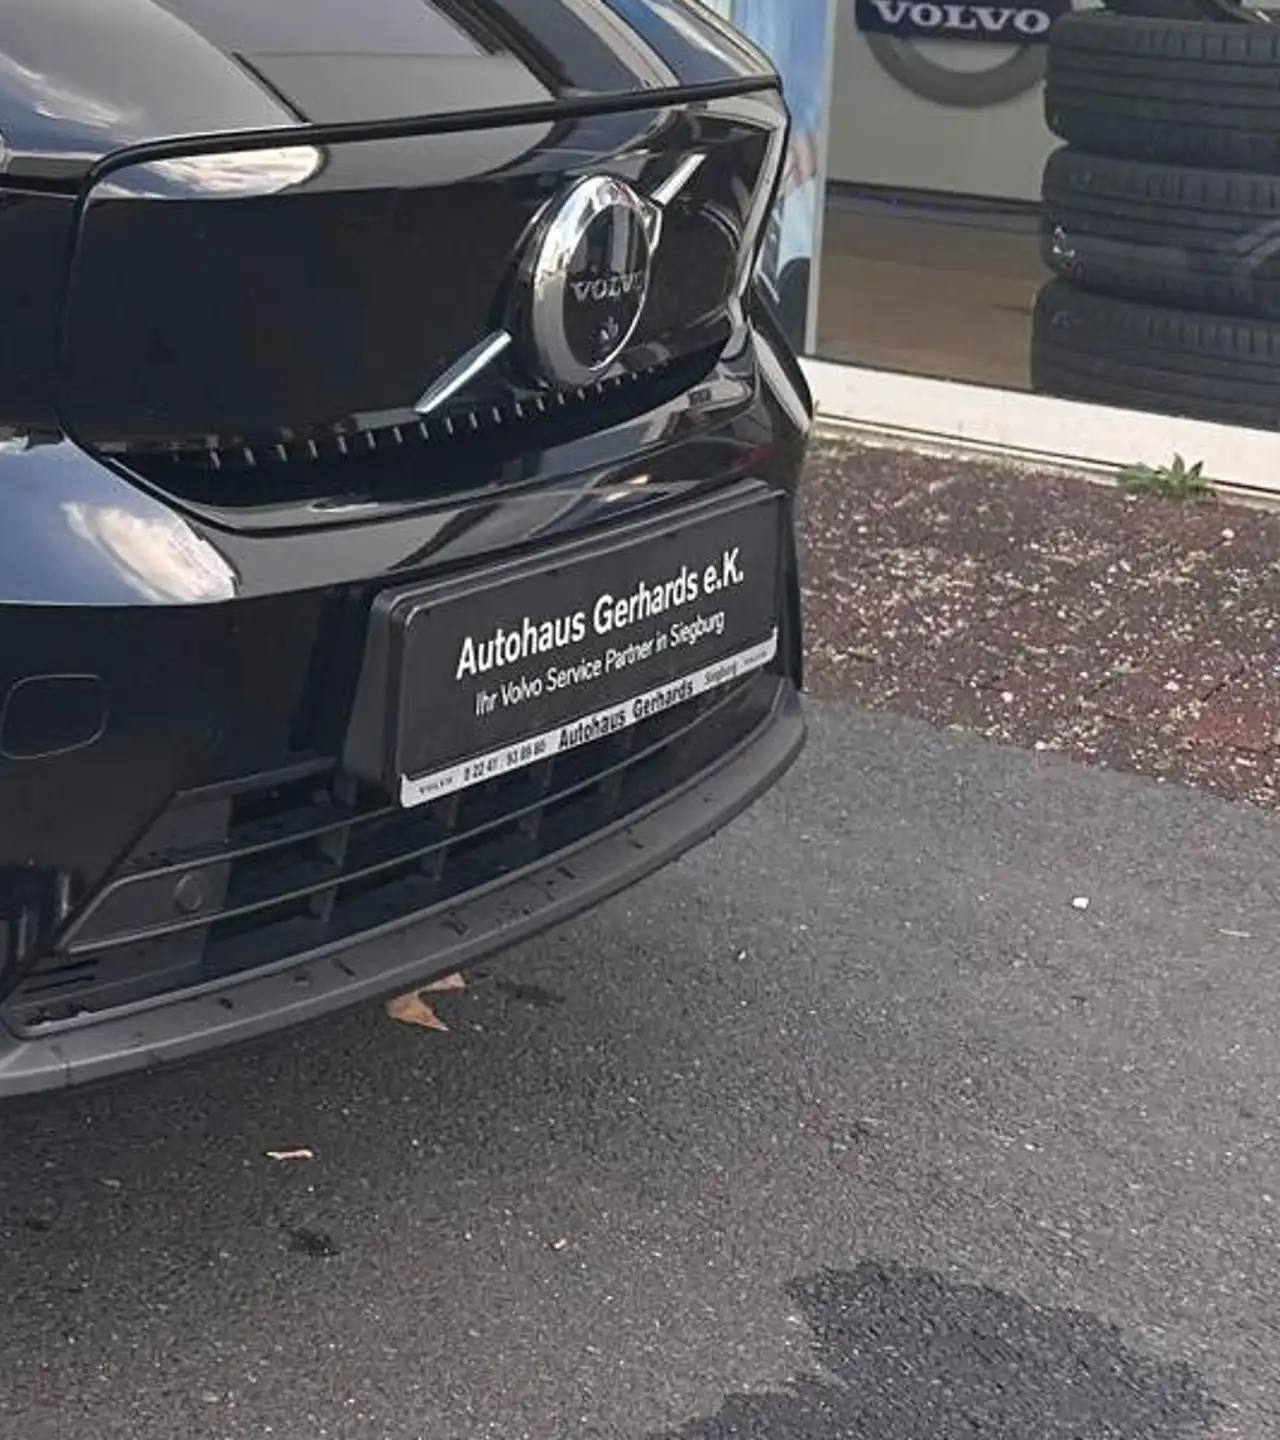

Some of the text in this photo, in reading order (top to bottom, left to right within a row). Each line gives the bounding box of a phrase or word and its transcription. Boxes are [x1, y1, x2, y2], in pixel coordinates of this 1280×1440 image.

[455, 547, 744, 681] Autohaus Gerhards e.K.
[475, 611, 725, 717] Ihr Volvo Service Partner in Siegburg
[558, 709, 627, 750] Autohaus
[633, 680, 694, 719] Gerhards
